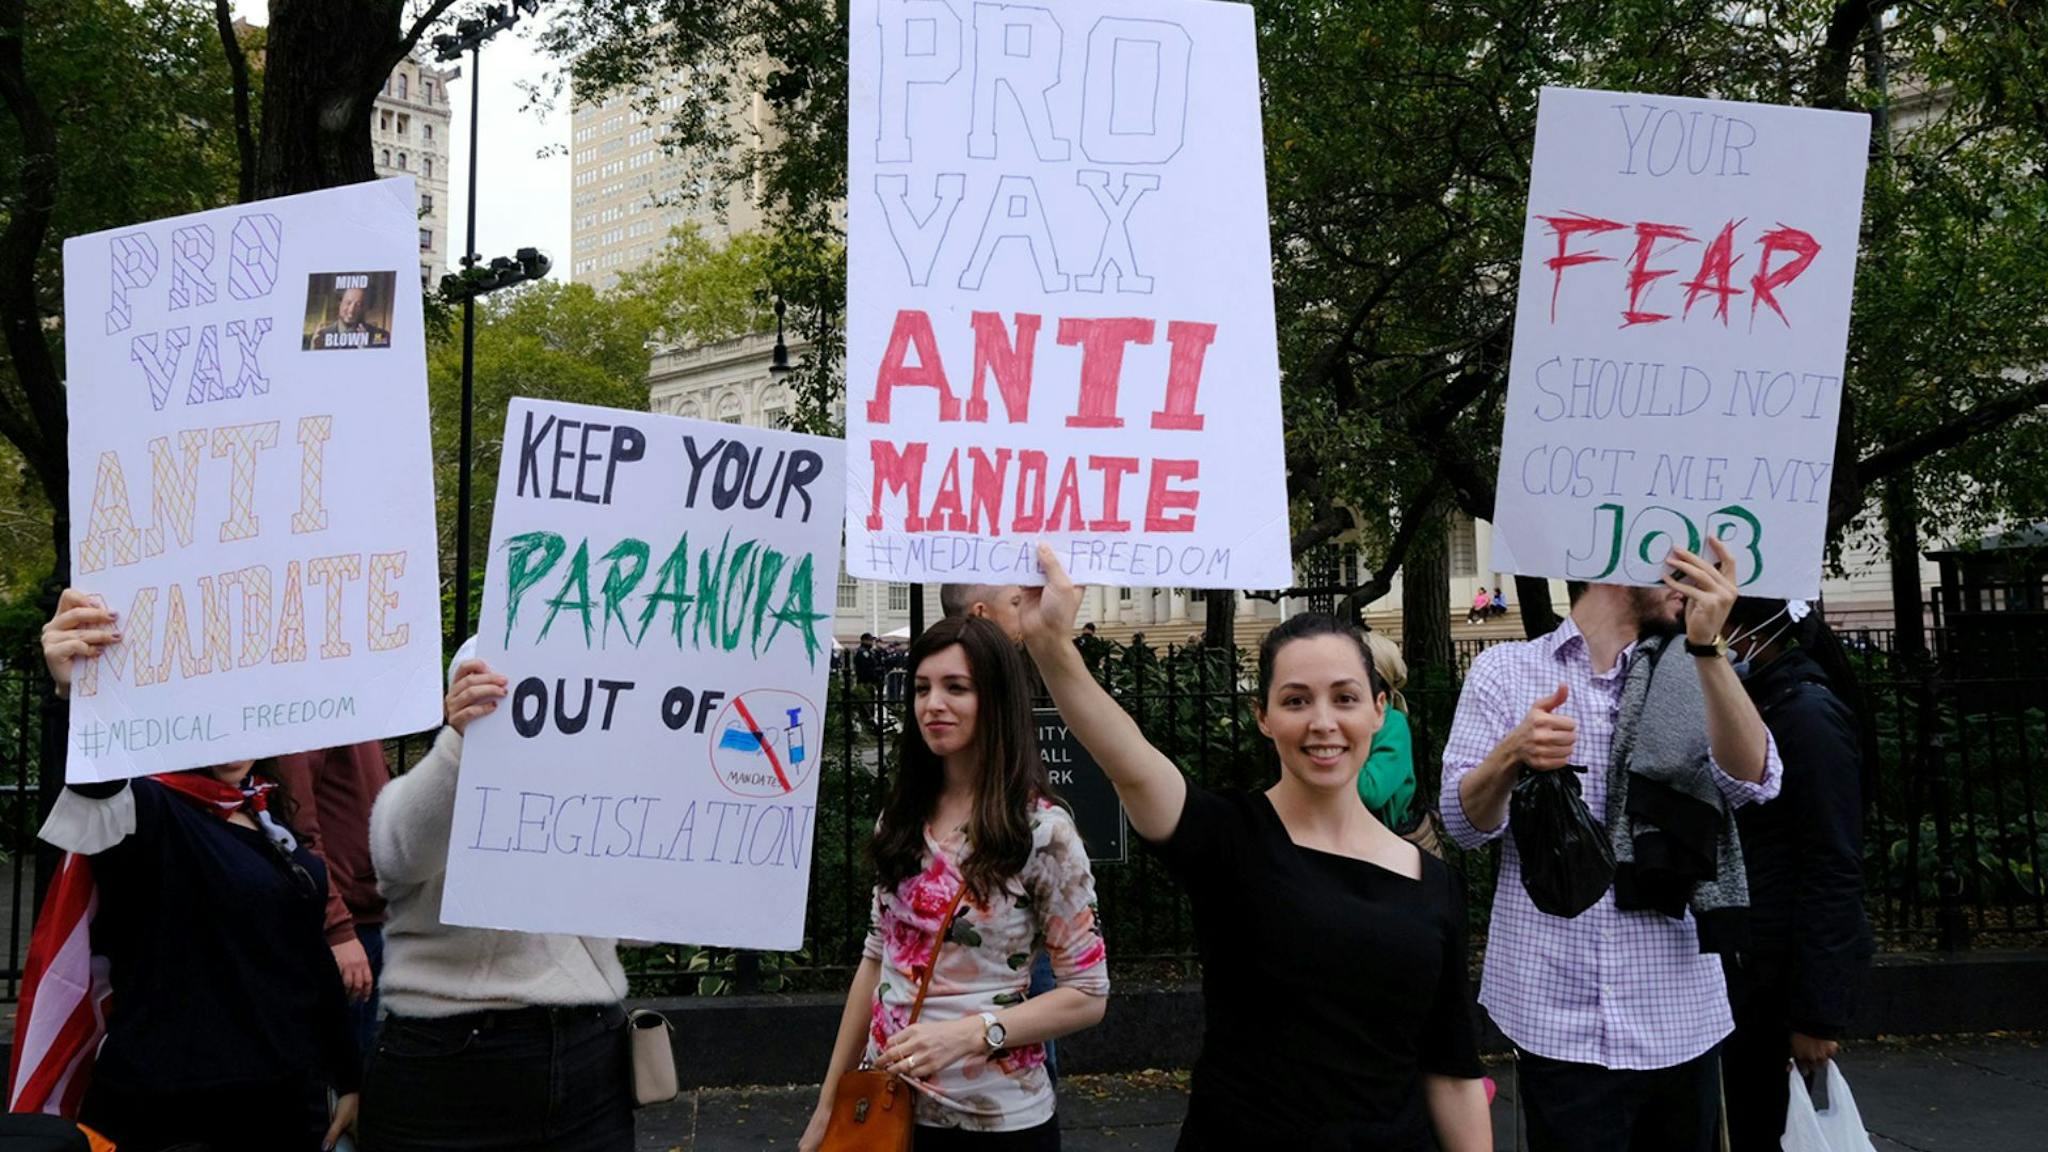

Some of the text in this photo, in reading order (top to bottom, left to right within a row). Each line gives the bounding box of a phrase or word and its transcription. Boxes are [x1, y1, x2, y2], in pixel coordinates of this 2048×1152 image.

[874, 0, 1194, 165] PRO
[1610, 103, 1757, 177] YOUR
[105, 212, 283, 336] PRO
[874, 169, 1161, 295] VAX
[1531, 209, 1823, 334] FEAR
[335, 274, 369, 290] MIND
[130, 317, 273, 411] VAX
[324, 331, 369, 347] BLOWN
[866, 309, 1218, 431] ANTI
[1534, 355, 1839, 422] SHOULD NOT
[78, 414, 333, 575] ANTI
[516, 410, 824, 524] KEEP YOUR
[866, 439, 1201, 537] MANDATE
[1521, 444, 1832, 504] COST ME MY
[1068, 538, 1232, 580] FREEDOM
[1565, 502, 1763, 588] JOB
[78, 550, 410, 698] MANDATE
[497, 526, 831, 674] PARANOIA
[77, 696, 357, 759] #MEDICAL FREEDOM
[511, 676, 726, 739] OUT OF
[1039, 727, 1069, 741] ITY
[1041, 748, 1072, 762] ALL
[467, 786, 815, 869] LEGISLATION
